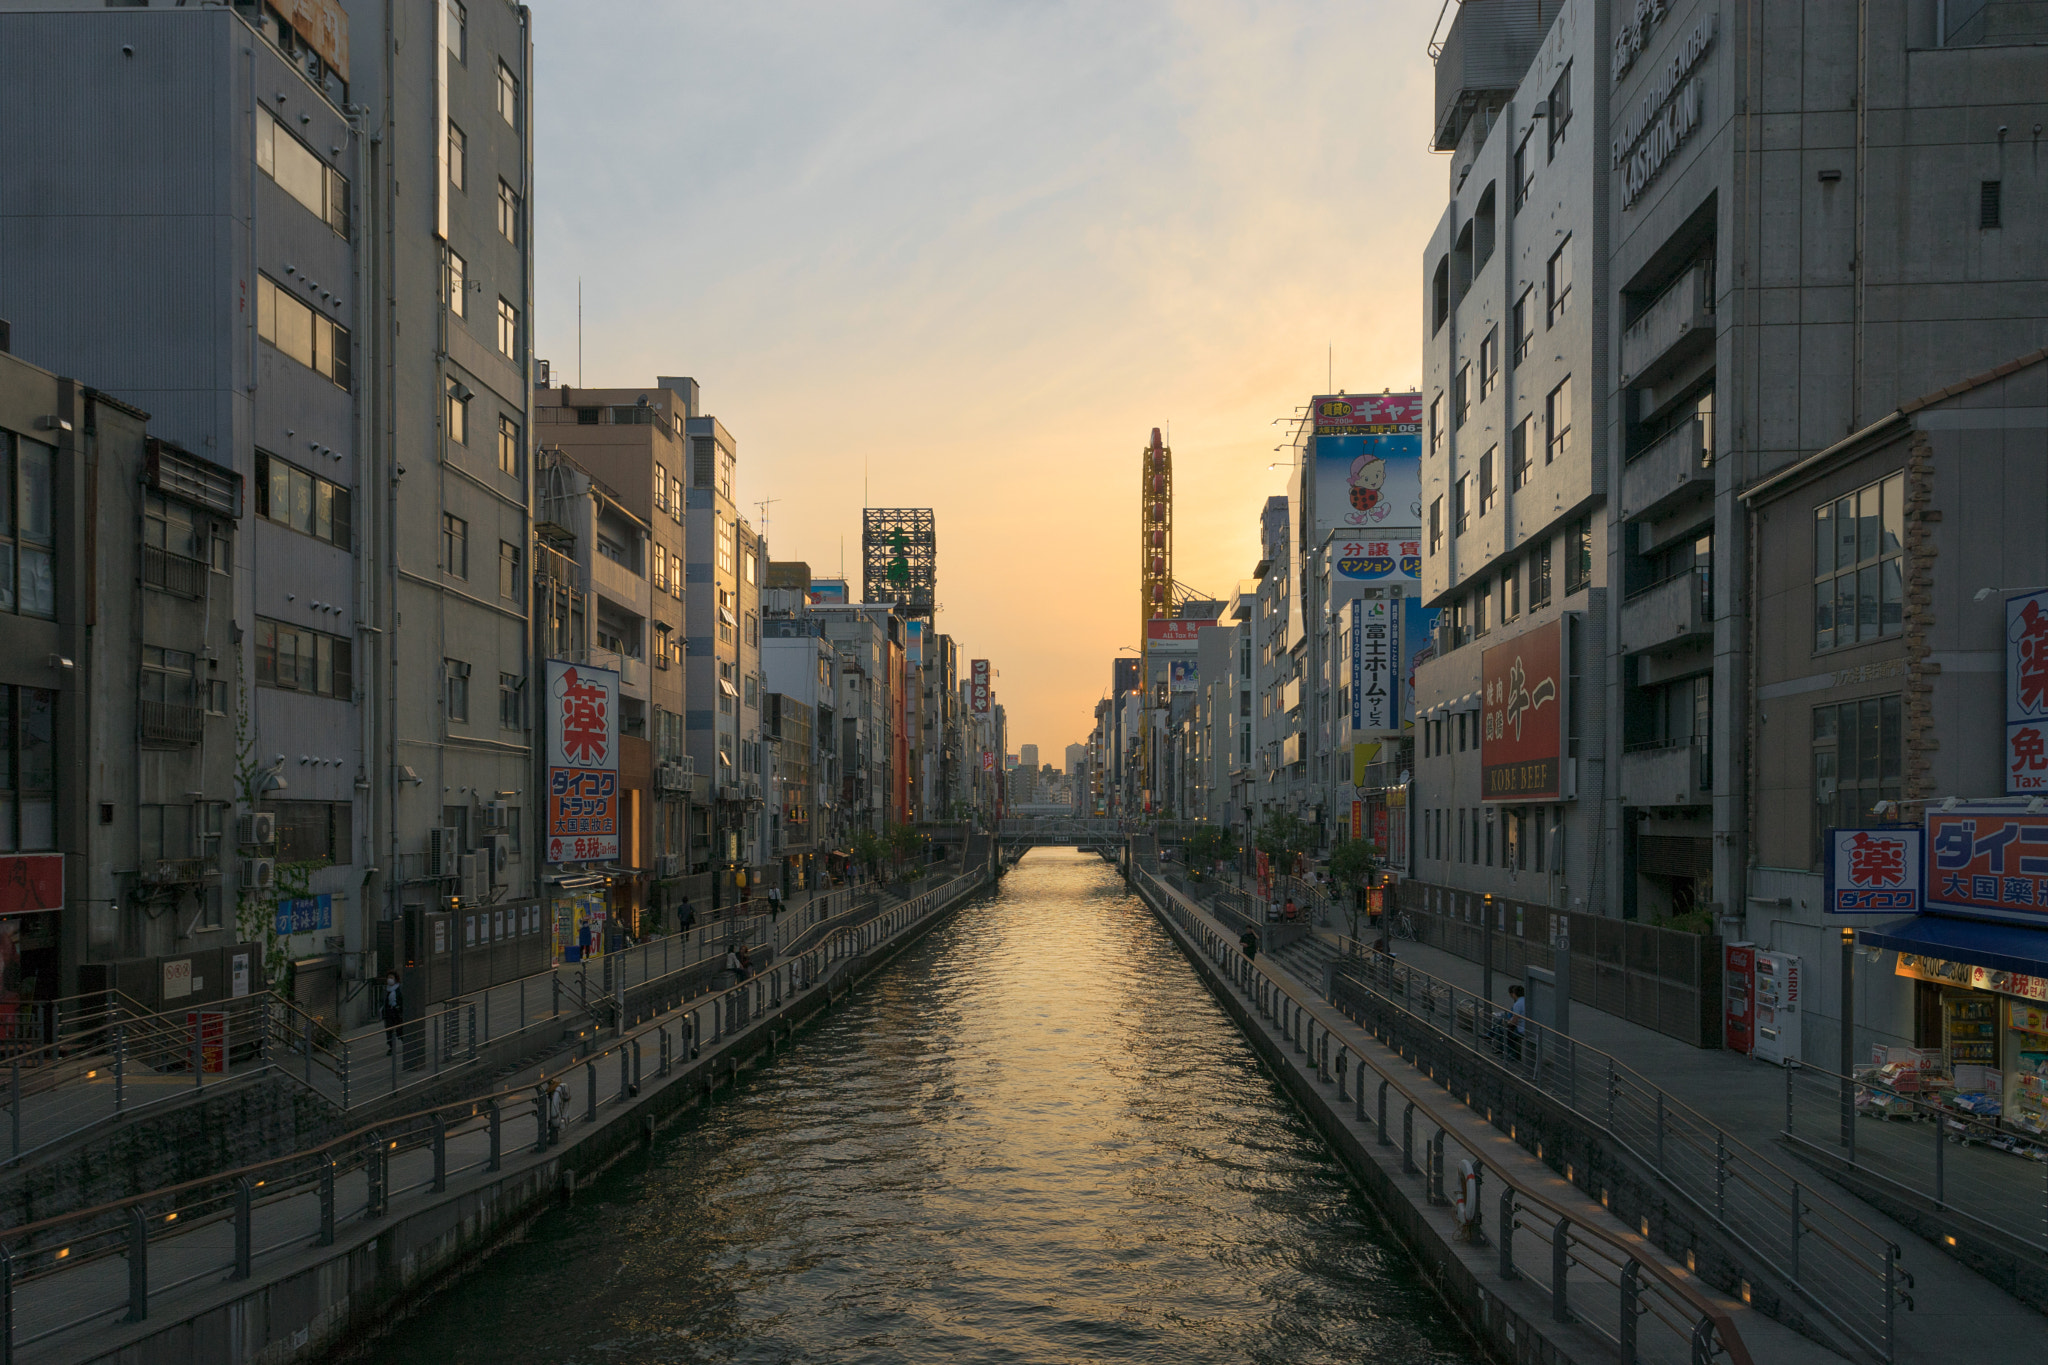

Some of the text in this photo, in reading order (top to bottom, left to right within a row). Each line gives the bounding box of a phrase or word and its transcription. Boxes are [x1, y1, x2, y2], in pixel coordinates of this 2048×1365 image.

[1658, 13, 1713, 107] HIDENOBU
[1621, 78, 1699, 212] KASHOKAN
[1343, 542, 1389, 556] 分譲
[1340, 559, 1393, 573] マンション
[1364, 623, 1387, 727] 富士ホームサービス
[563, 682, 607, 761] 薬
[552, 770, 615, 797] ダイコク
[1490, 764, 1548, 792] KOBE BEEF
[559, 797, 608, 817] ドラッグ
[574, 837, 600, 859] 免税
[1851, 836, 1904, 886] 薬
[1841, 891, 1912, 908] ダイコク
[1788, 968, 1798, 1002] KIRIN
